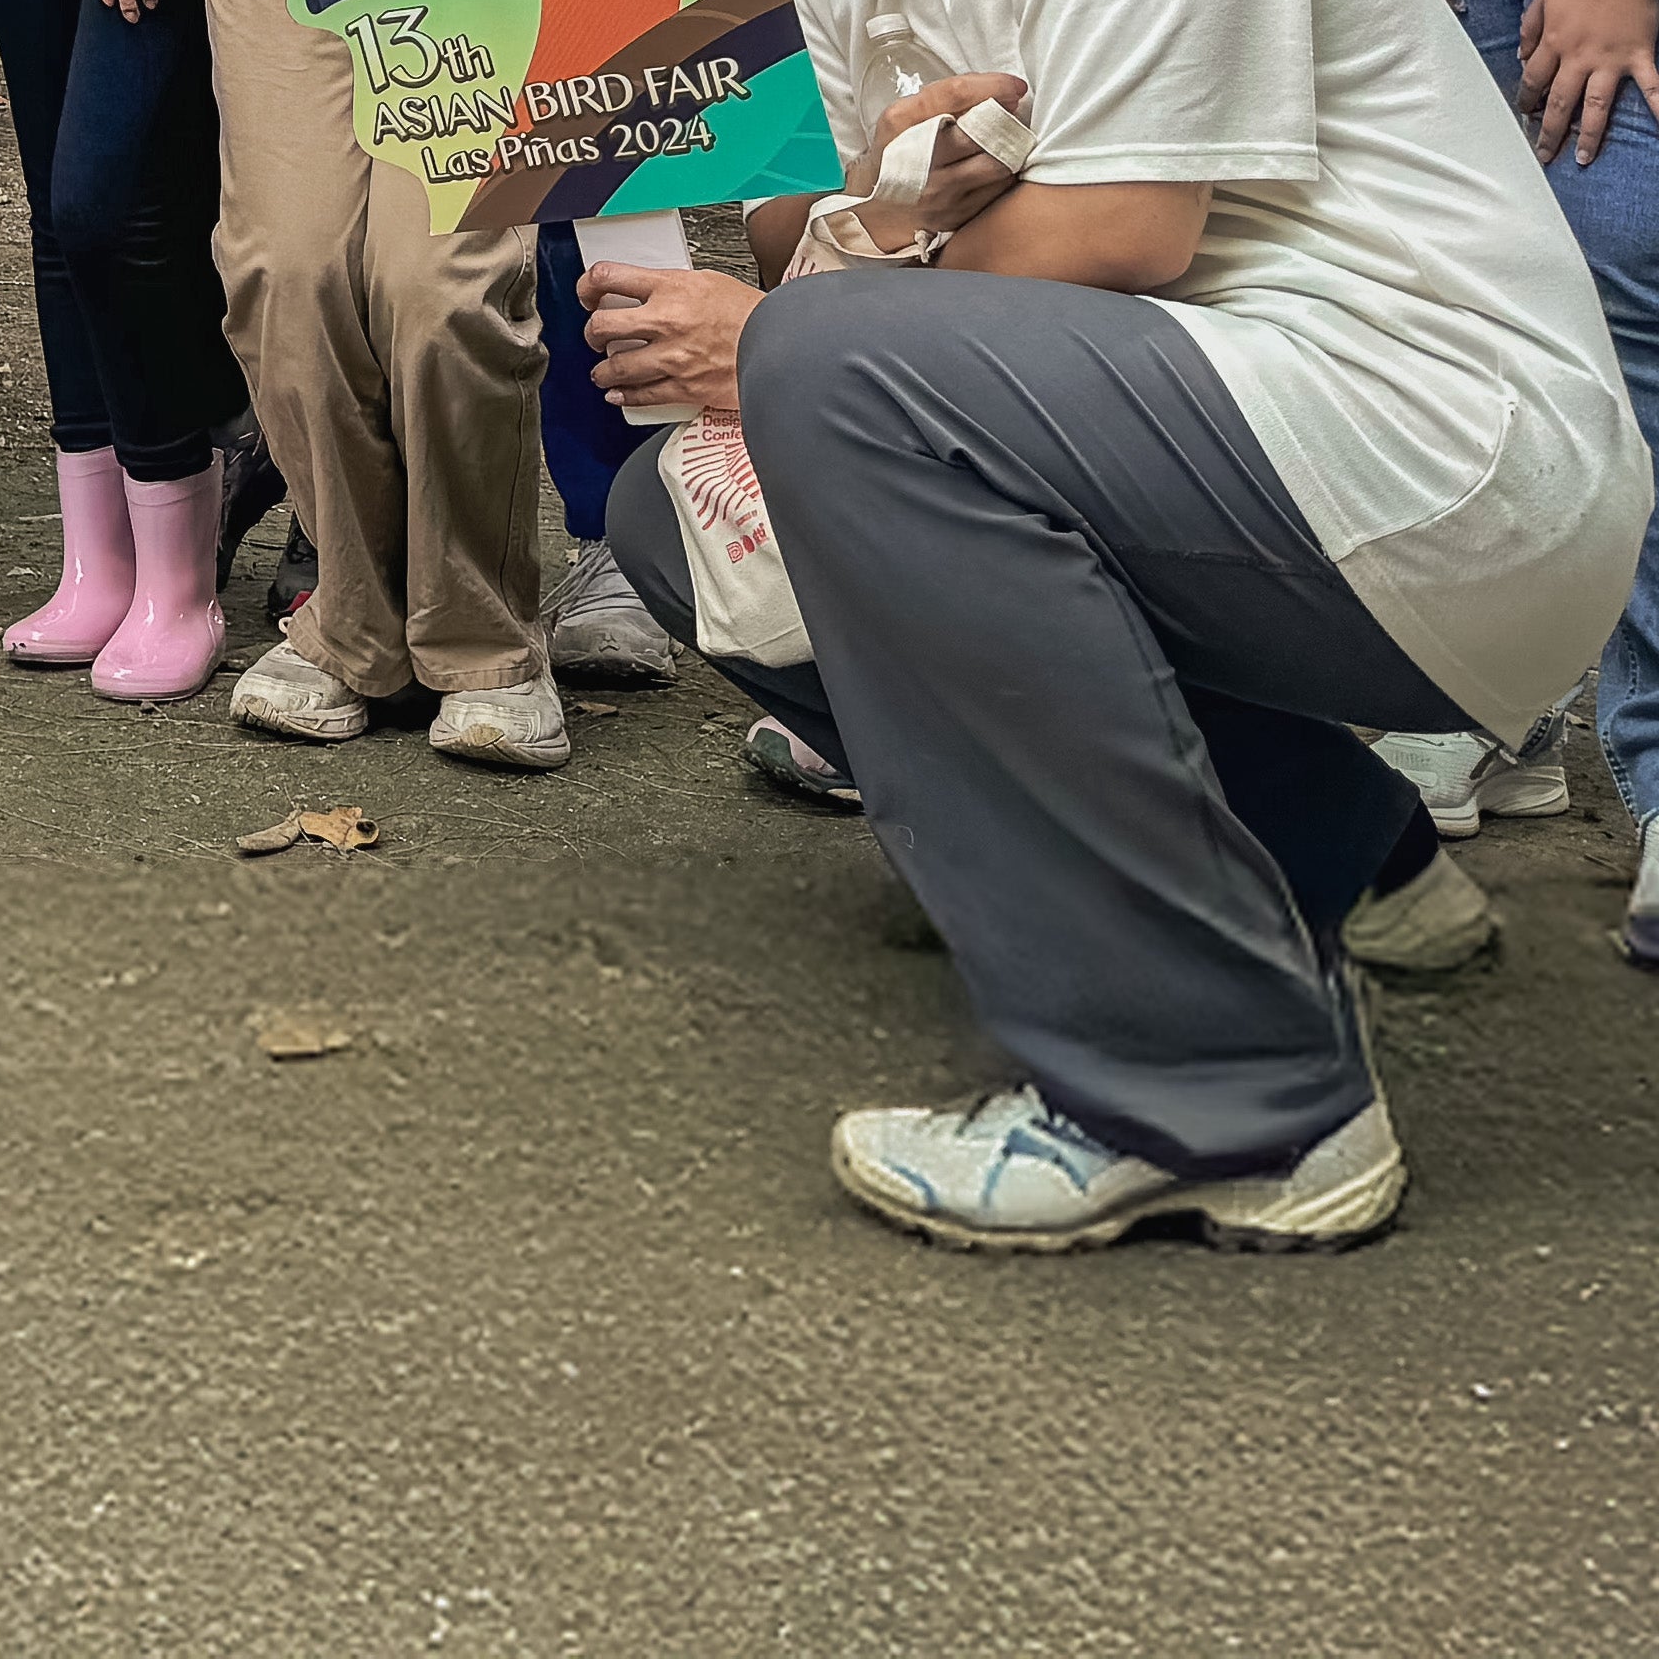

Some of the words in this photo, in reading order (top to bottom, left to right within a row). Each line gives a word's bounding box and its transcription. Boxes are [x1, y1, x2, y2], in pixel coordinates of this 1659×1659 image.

[345, 5, 496, 94] 13th
[373, 86, 517, 145] ASIAN
[525, 72, 634, 124] BIRD
[644, 56, 752, 109] FAIR
[421, 147, 495, 184] Las
[497, 133, 599, 172] Piñas
[609, 114, 717, 159] 2024
